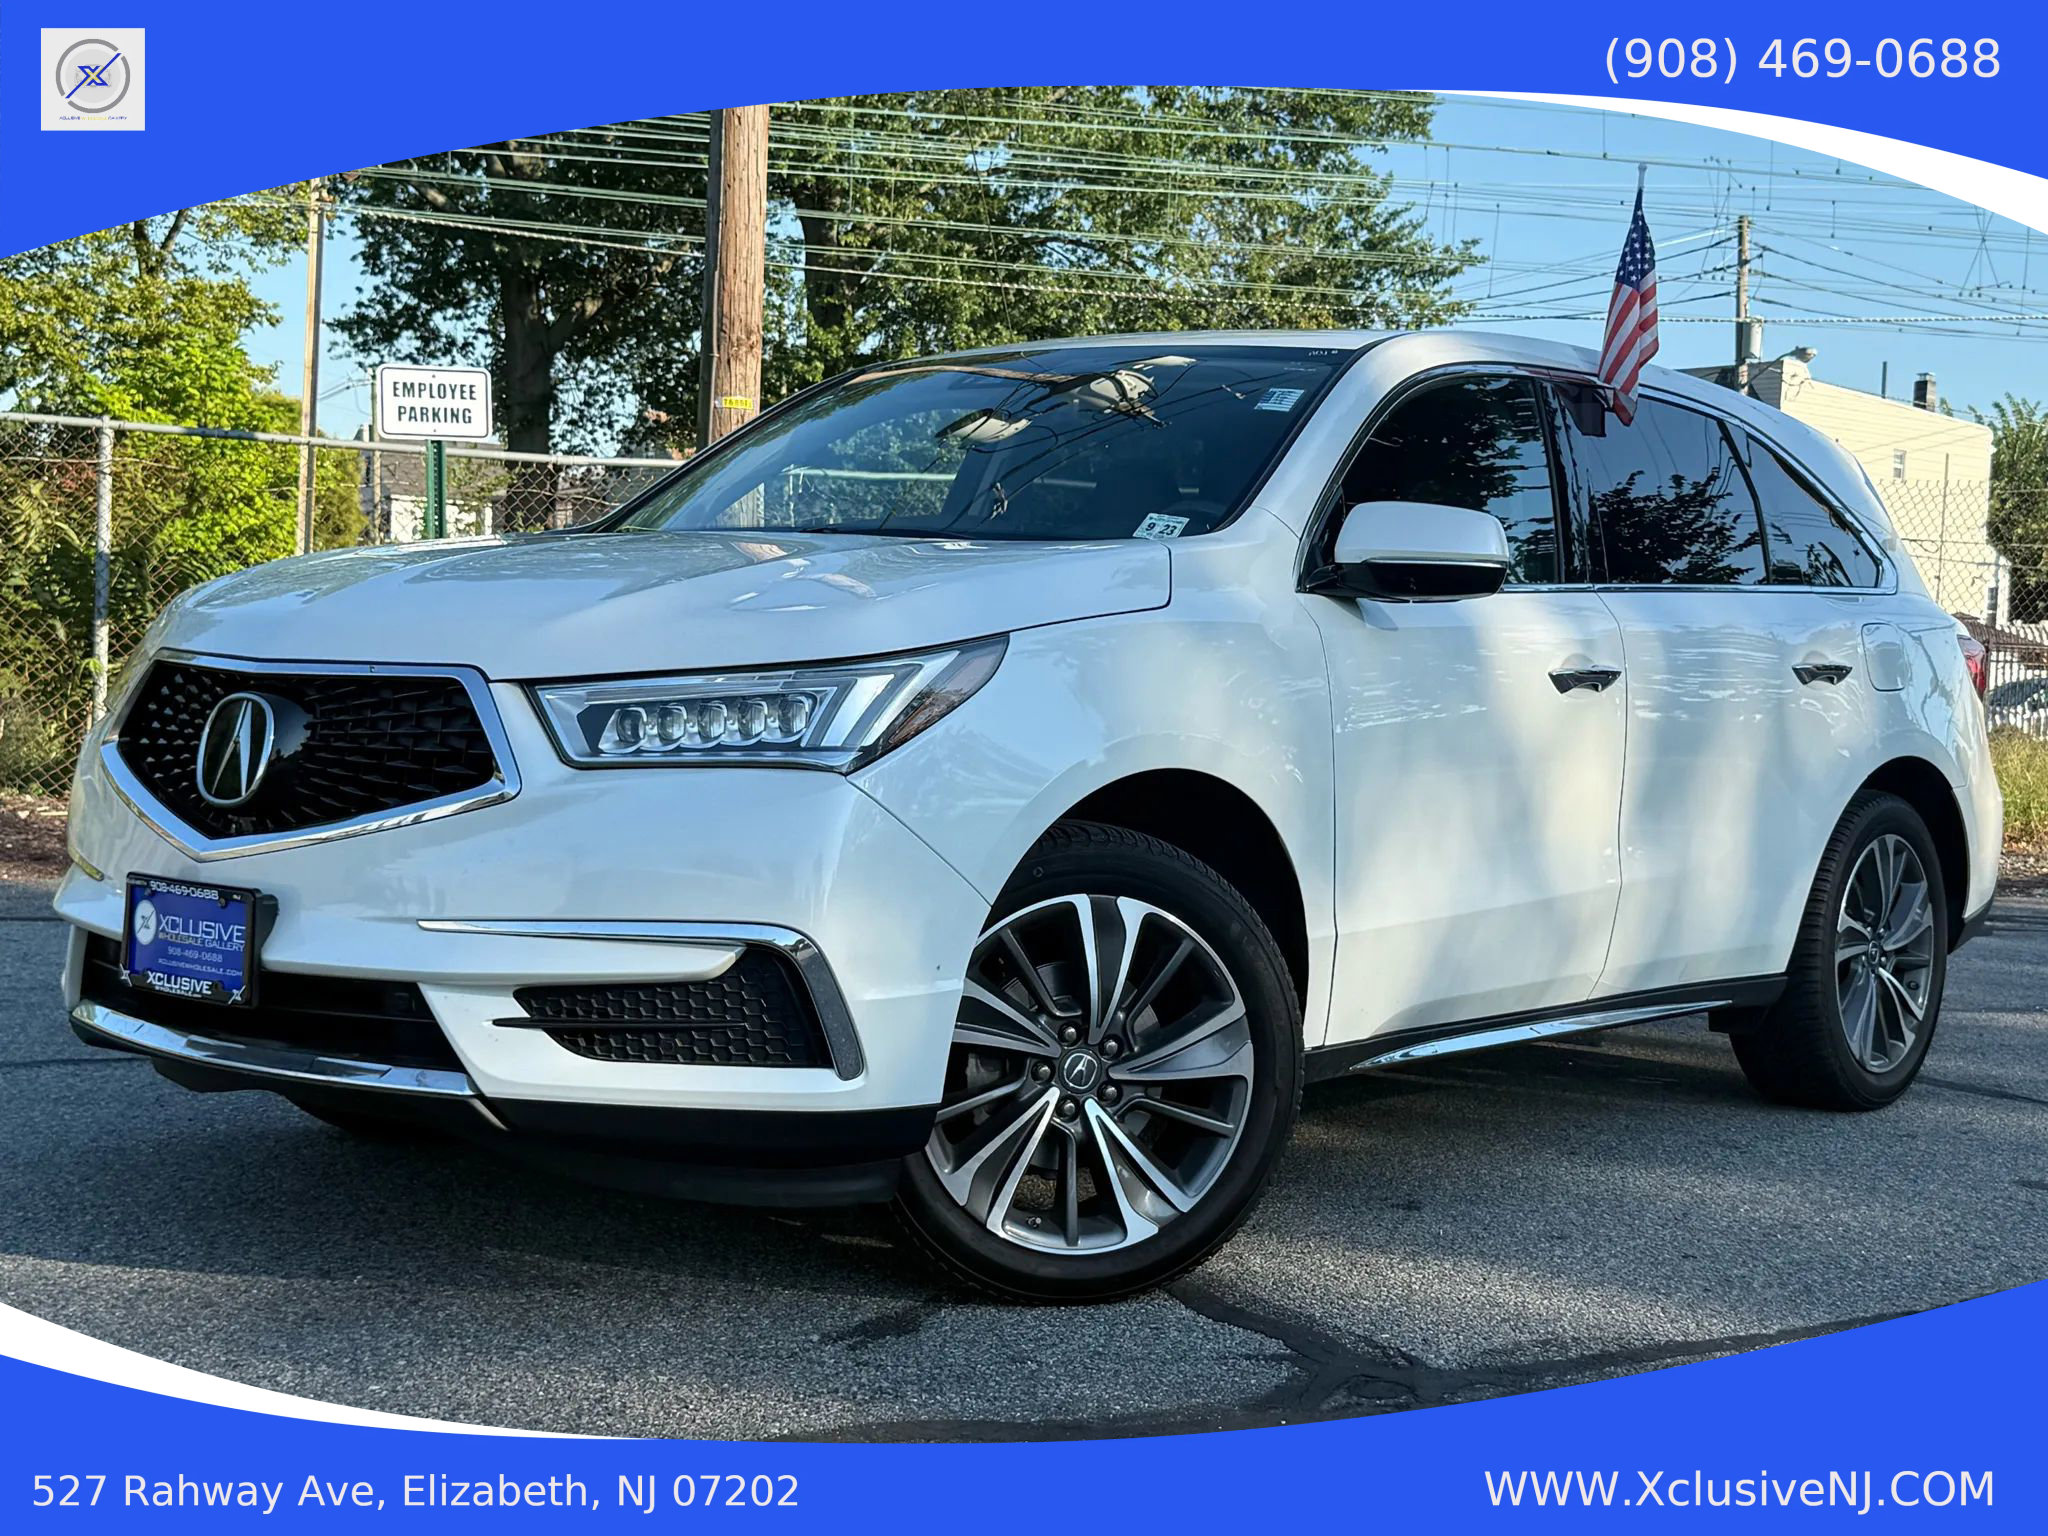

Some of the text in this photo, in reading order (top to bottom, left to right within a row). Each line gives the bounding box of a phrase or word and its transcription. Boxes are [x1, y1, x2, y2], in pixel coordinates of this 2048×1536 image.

[393, 381, 477, 401] EMPLOYEE
[398, 405, 472, 424] PARKING
[1145, 522, 1177, 536] 9 23
[150, 880, 219, 900] 908-469-0688
[159, 914, 246, 944] XCLUSIVE
[158, 931, 246, 953] WHOLESALE GALLERY
[168, 946, 223, 963] 908-469-0688
[147, 970, 212, 995] XCLUSIVE
